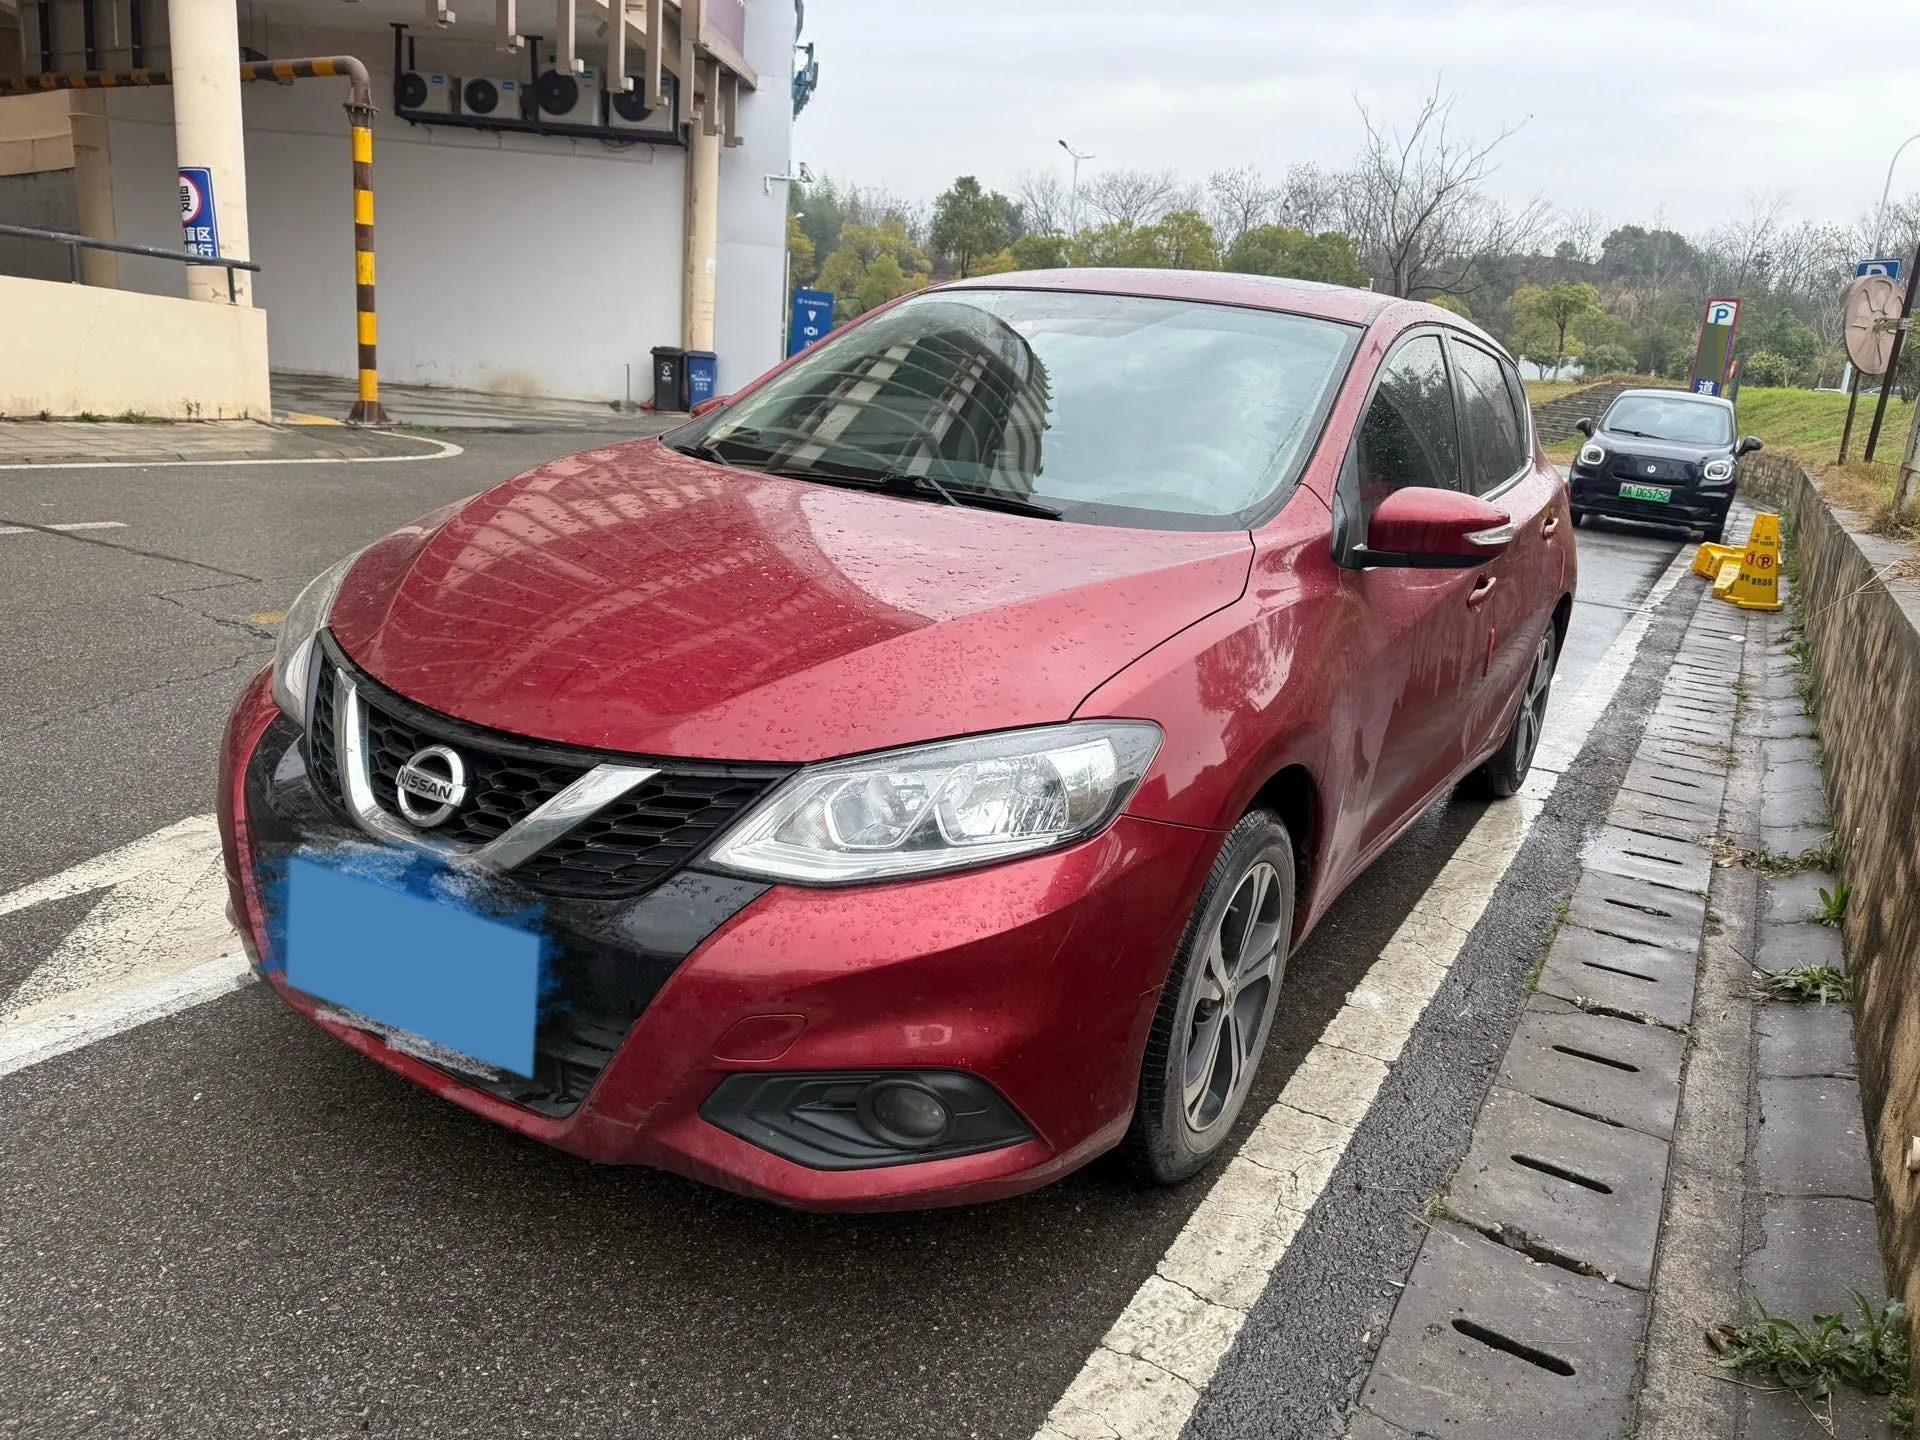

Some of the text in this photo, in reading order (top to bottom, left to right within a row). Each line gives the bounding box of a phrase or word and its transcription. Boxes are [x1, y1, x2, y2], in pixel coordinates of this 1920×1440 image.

[184, 227, 212, 242] 盲区
[1714, 308, 1729, 324] P
[1698, 380, 1714, 395] 道
[399, 769, 453, 800] NISSAN
